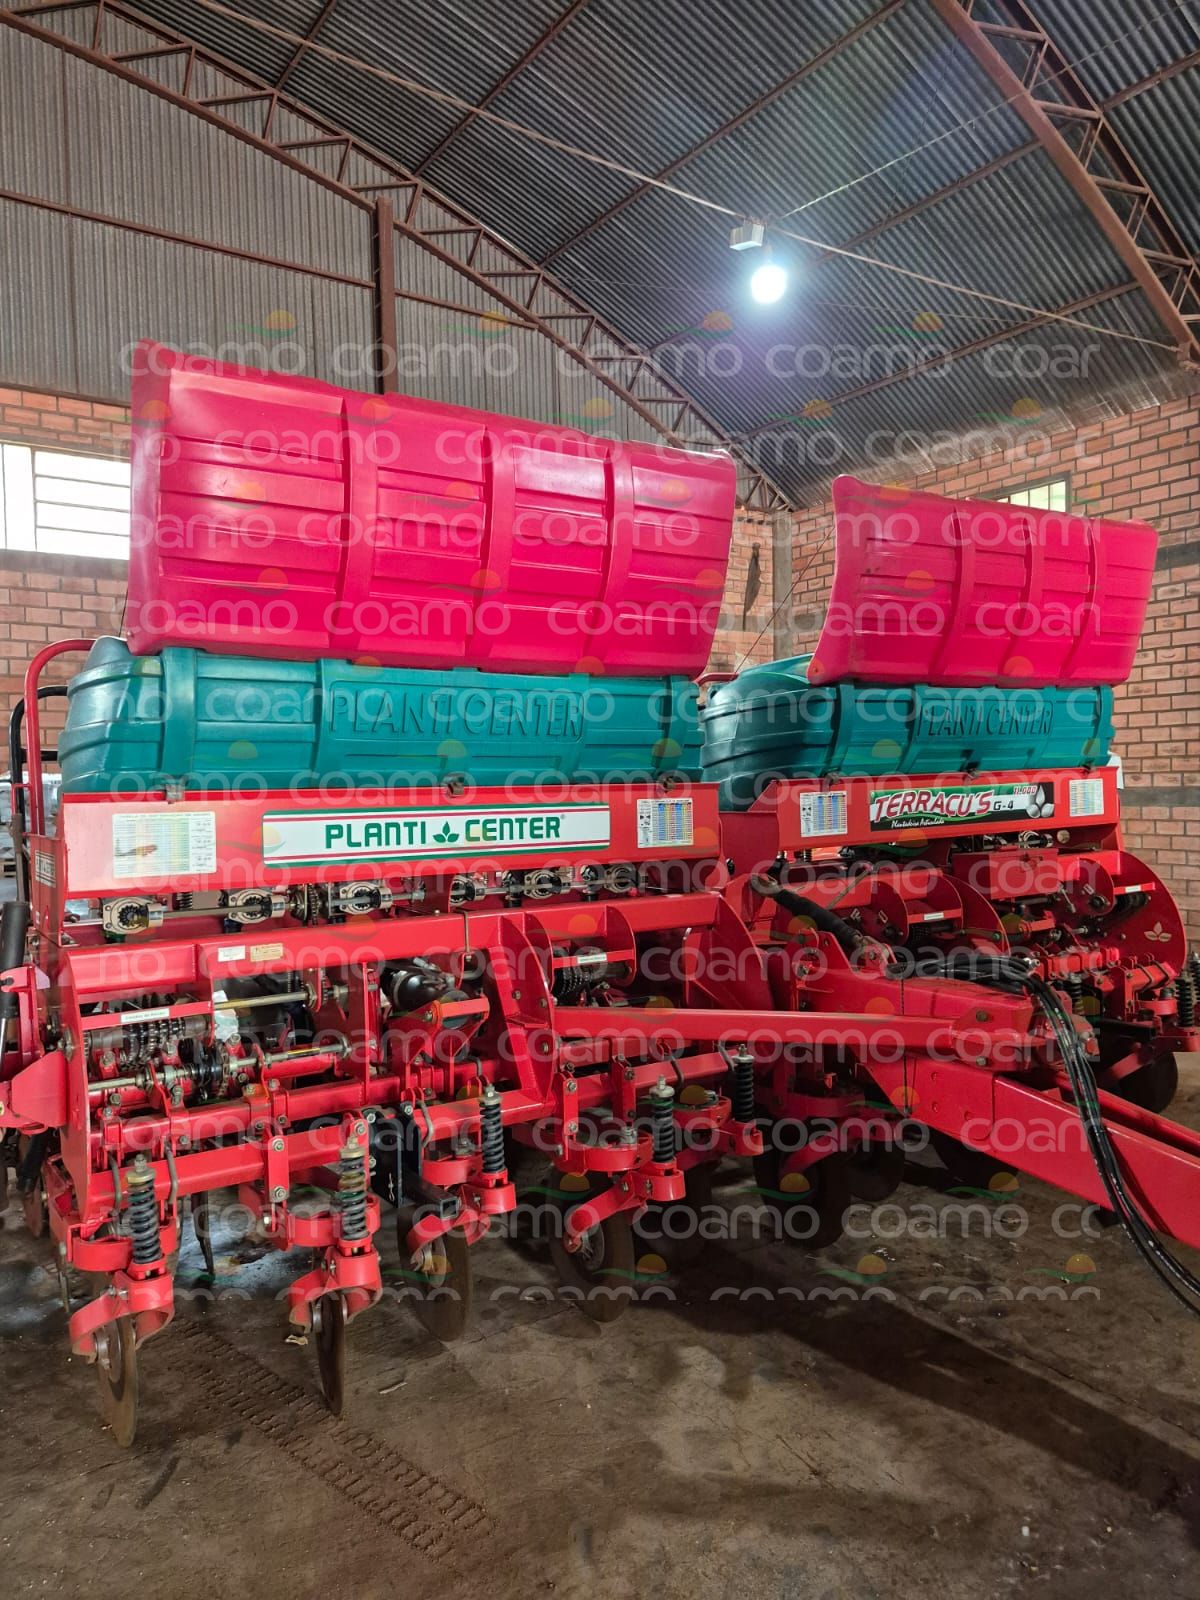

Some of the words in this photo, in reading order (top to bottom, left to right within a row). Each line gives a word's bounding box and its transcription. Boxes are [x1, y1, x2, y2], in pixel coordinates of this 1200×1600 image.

[330, 689, 453, 734] PLANTI
[464, 692, 583, 738] CENTER
[916, 704, 984, 737] PLANTI
[985, 703, 1053, 736] CENTER
[325, 820, 426, 849] PLANTI
[464, 816, 561, 842] CENTER
